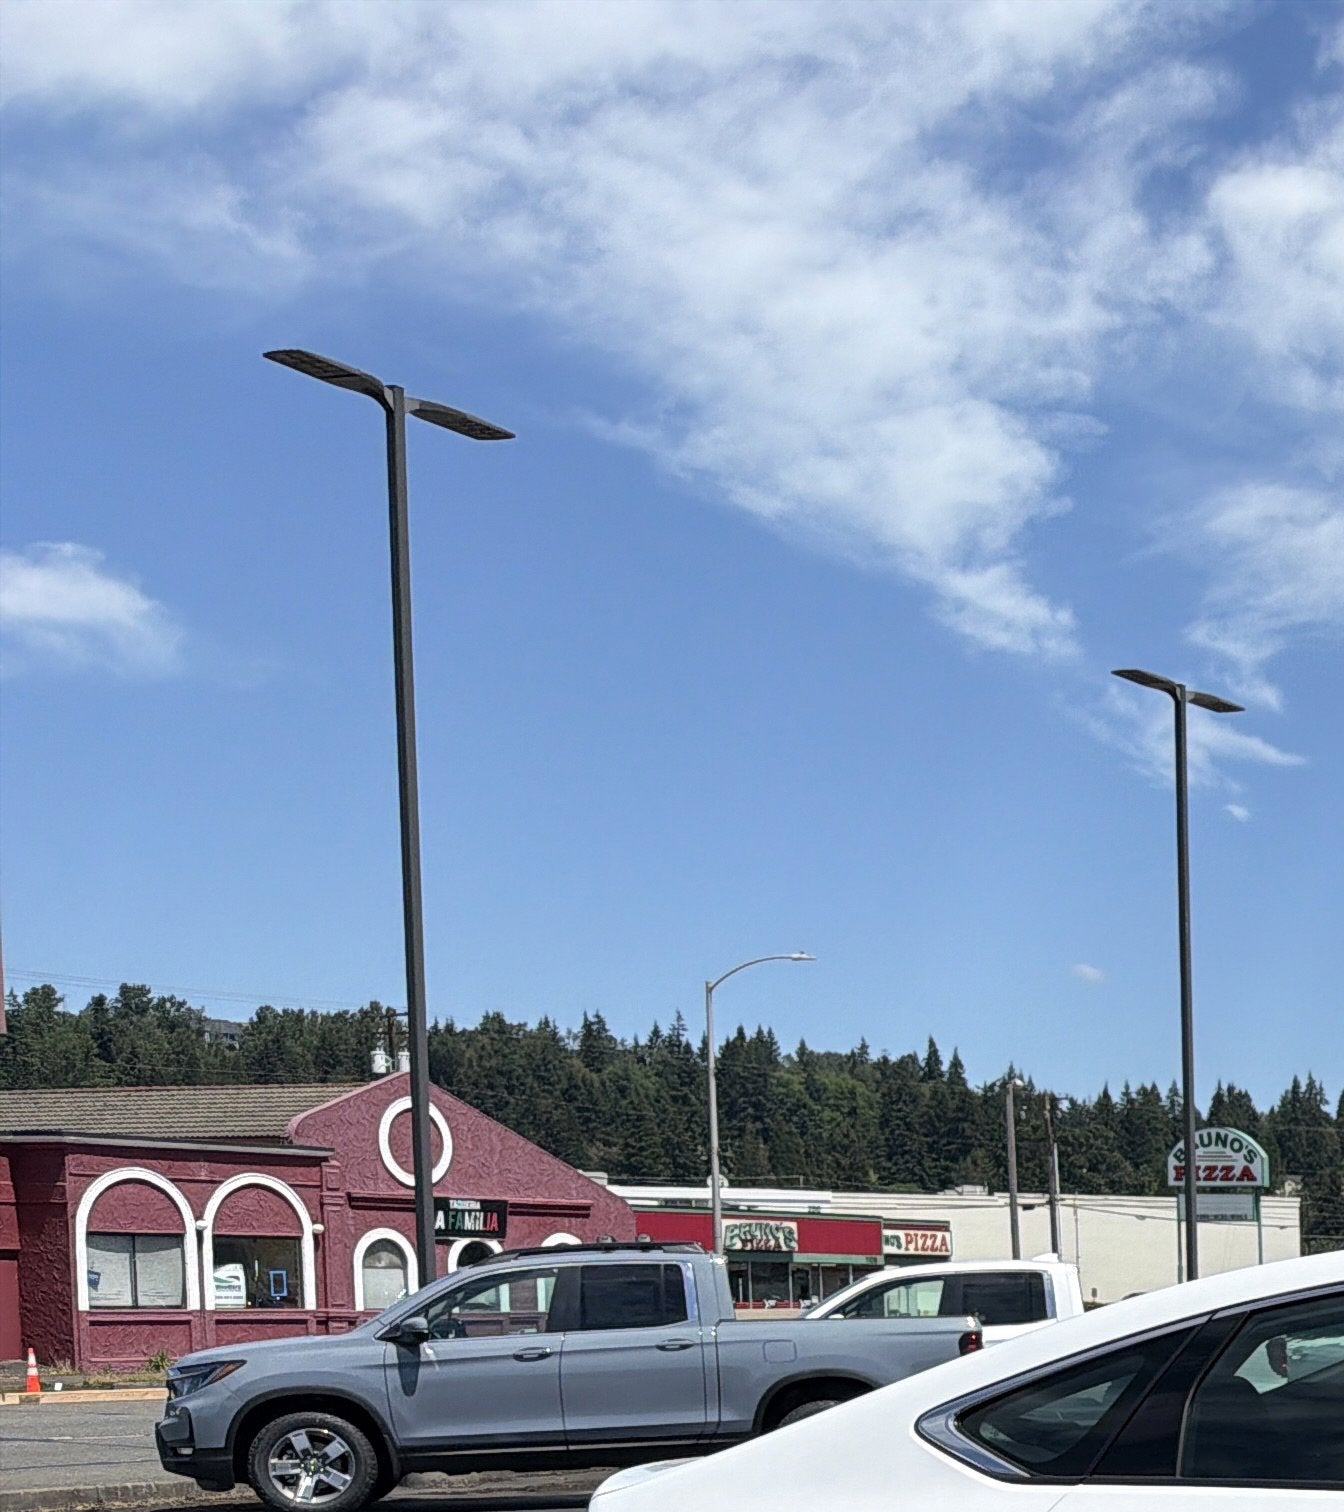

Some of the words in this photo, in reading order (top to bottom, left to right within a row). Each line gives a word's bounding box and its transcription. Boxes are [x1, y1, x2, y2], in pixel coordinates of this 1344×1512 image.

[1173, 1132, 1257, 1164] BUNO'S
[434, 1210, 446, 1230] A
[448, 1210, 499, 1231] FAMILIA
[883, 1234, 903, 1250] NO'S
[903, 1232, 950, 1253] PIZZA
